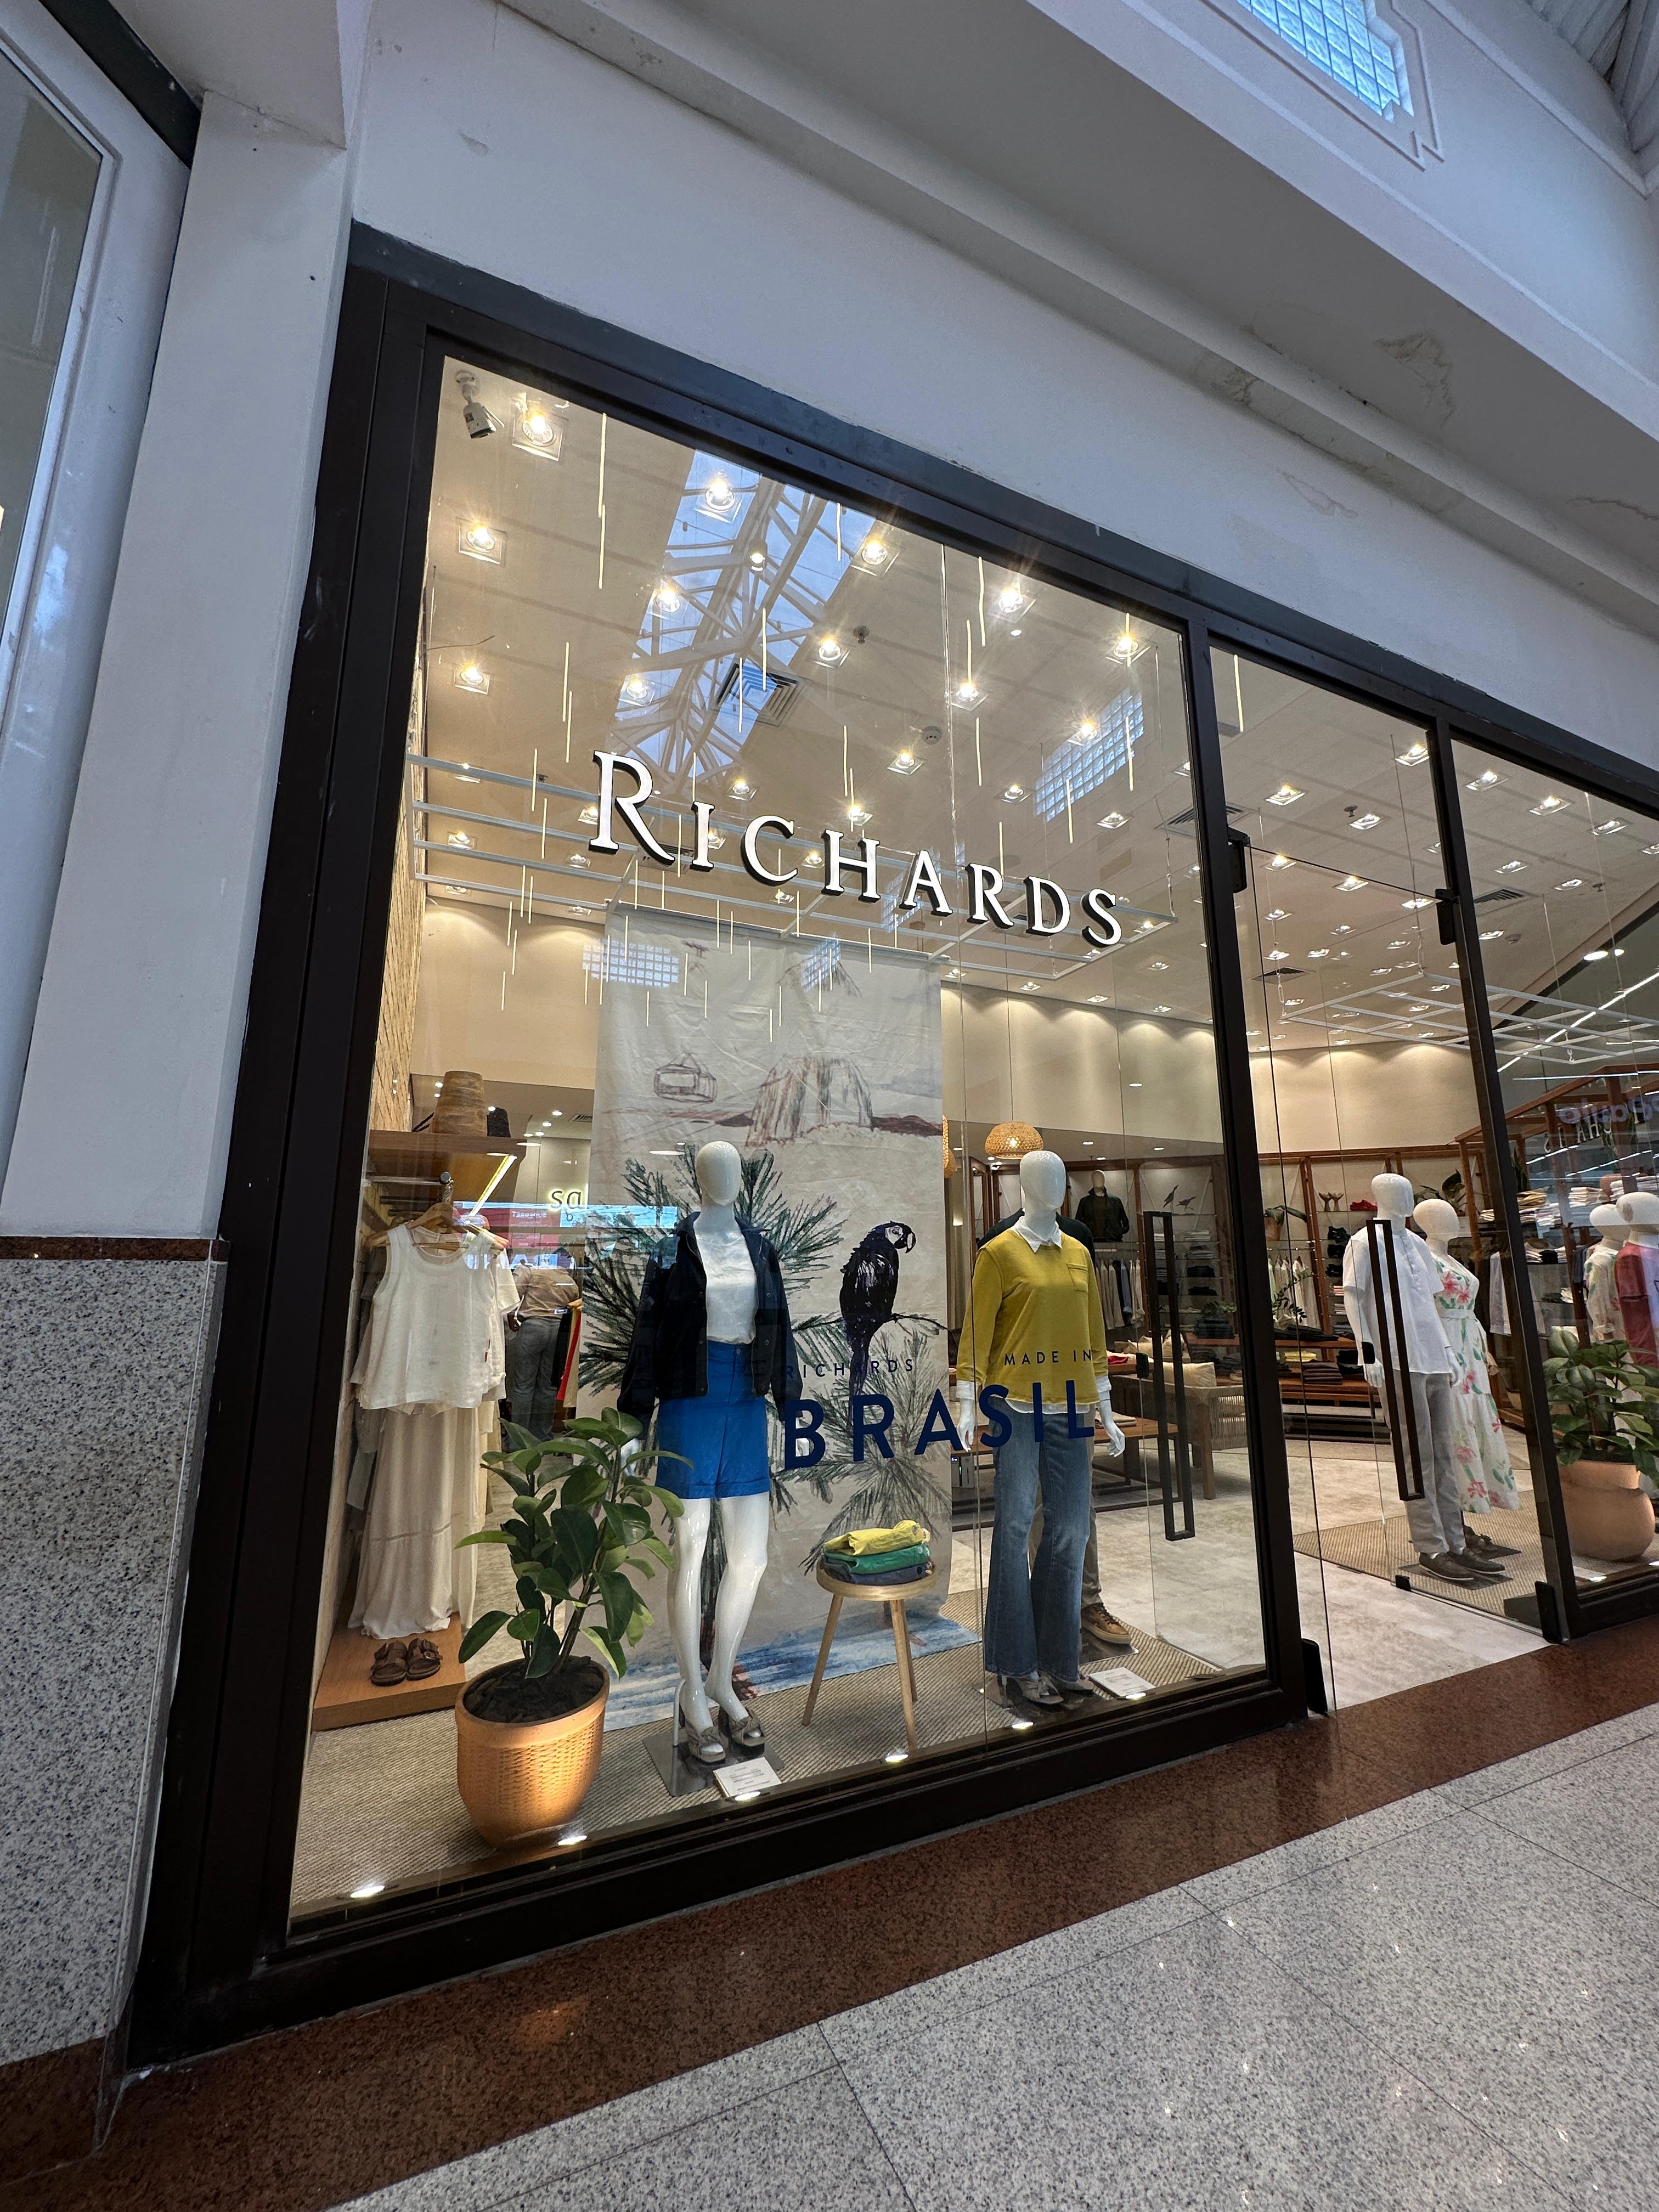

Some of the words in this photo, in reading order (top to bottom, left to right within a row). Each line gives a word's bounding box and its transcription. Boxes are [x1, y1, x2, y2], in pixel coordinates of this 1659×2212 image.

[588, 750, 1123, 948] RICHARDS
[1004, 1352, 1059, 1366] MADE
[1073, 1351, 1092, 1362] IN
[785, 1380, 1094, 1469] BRASIL
